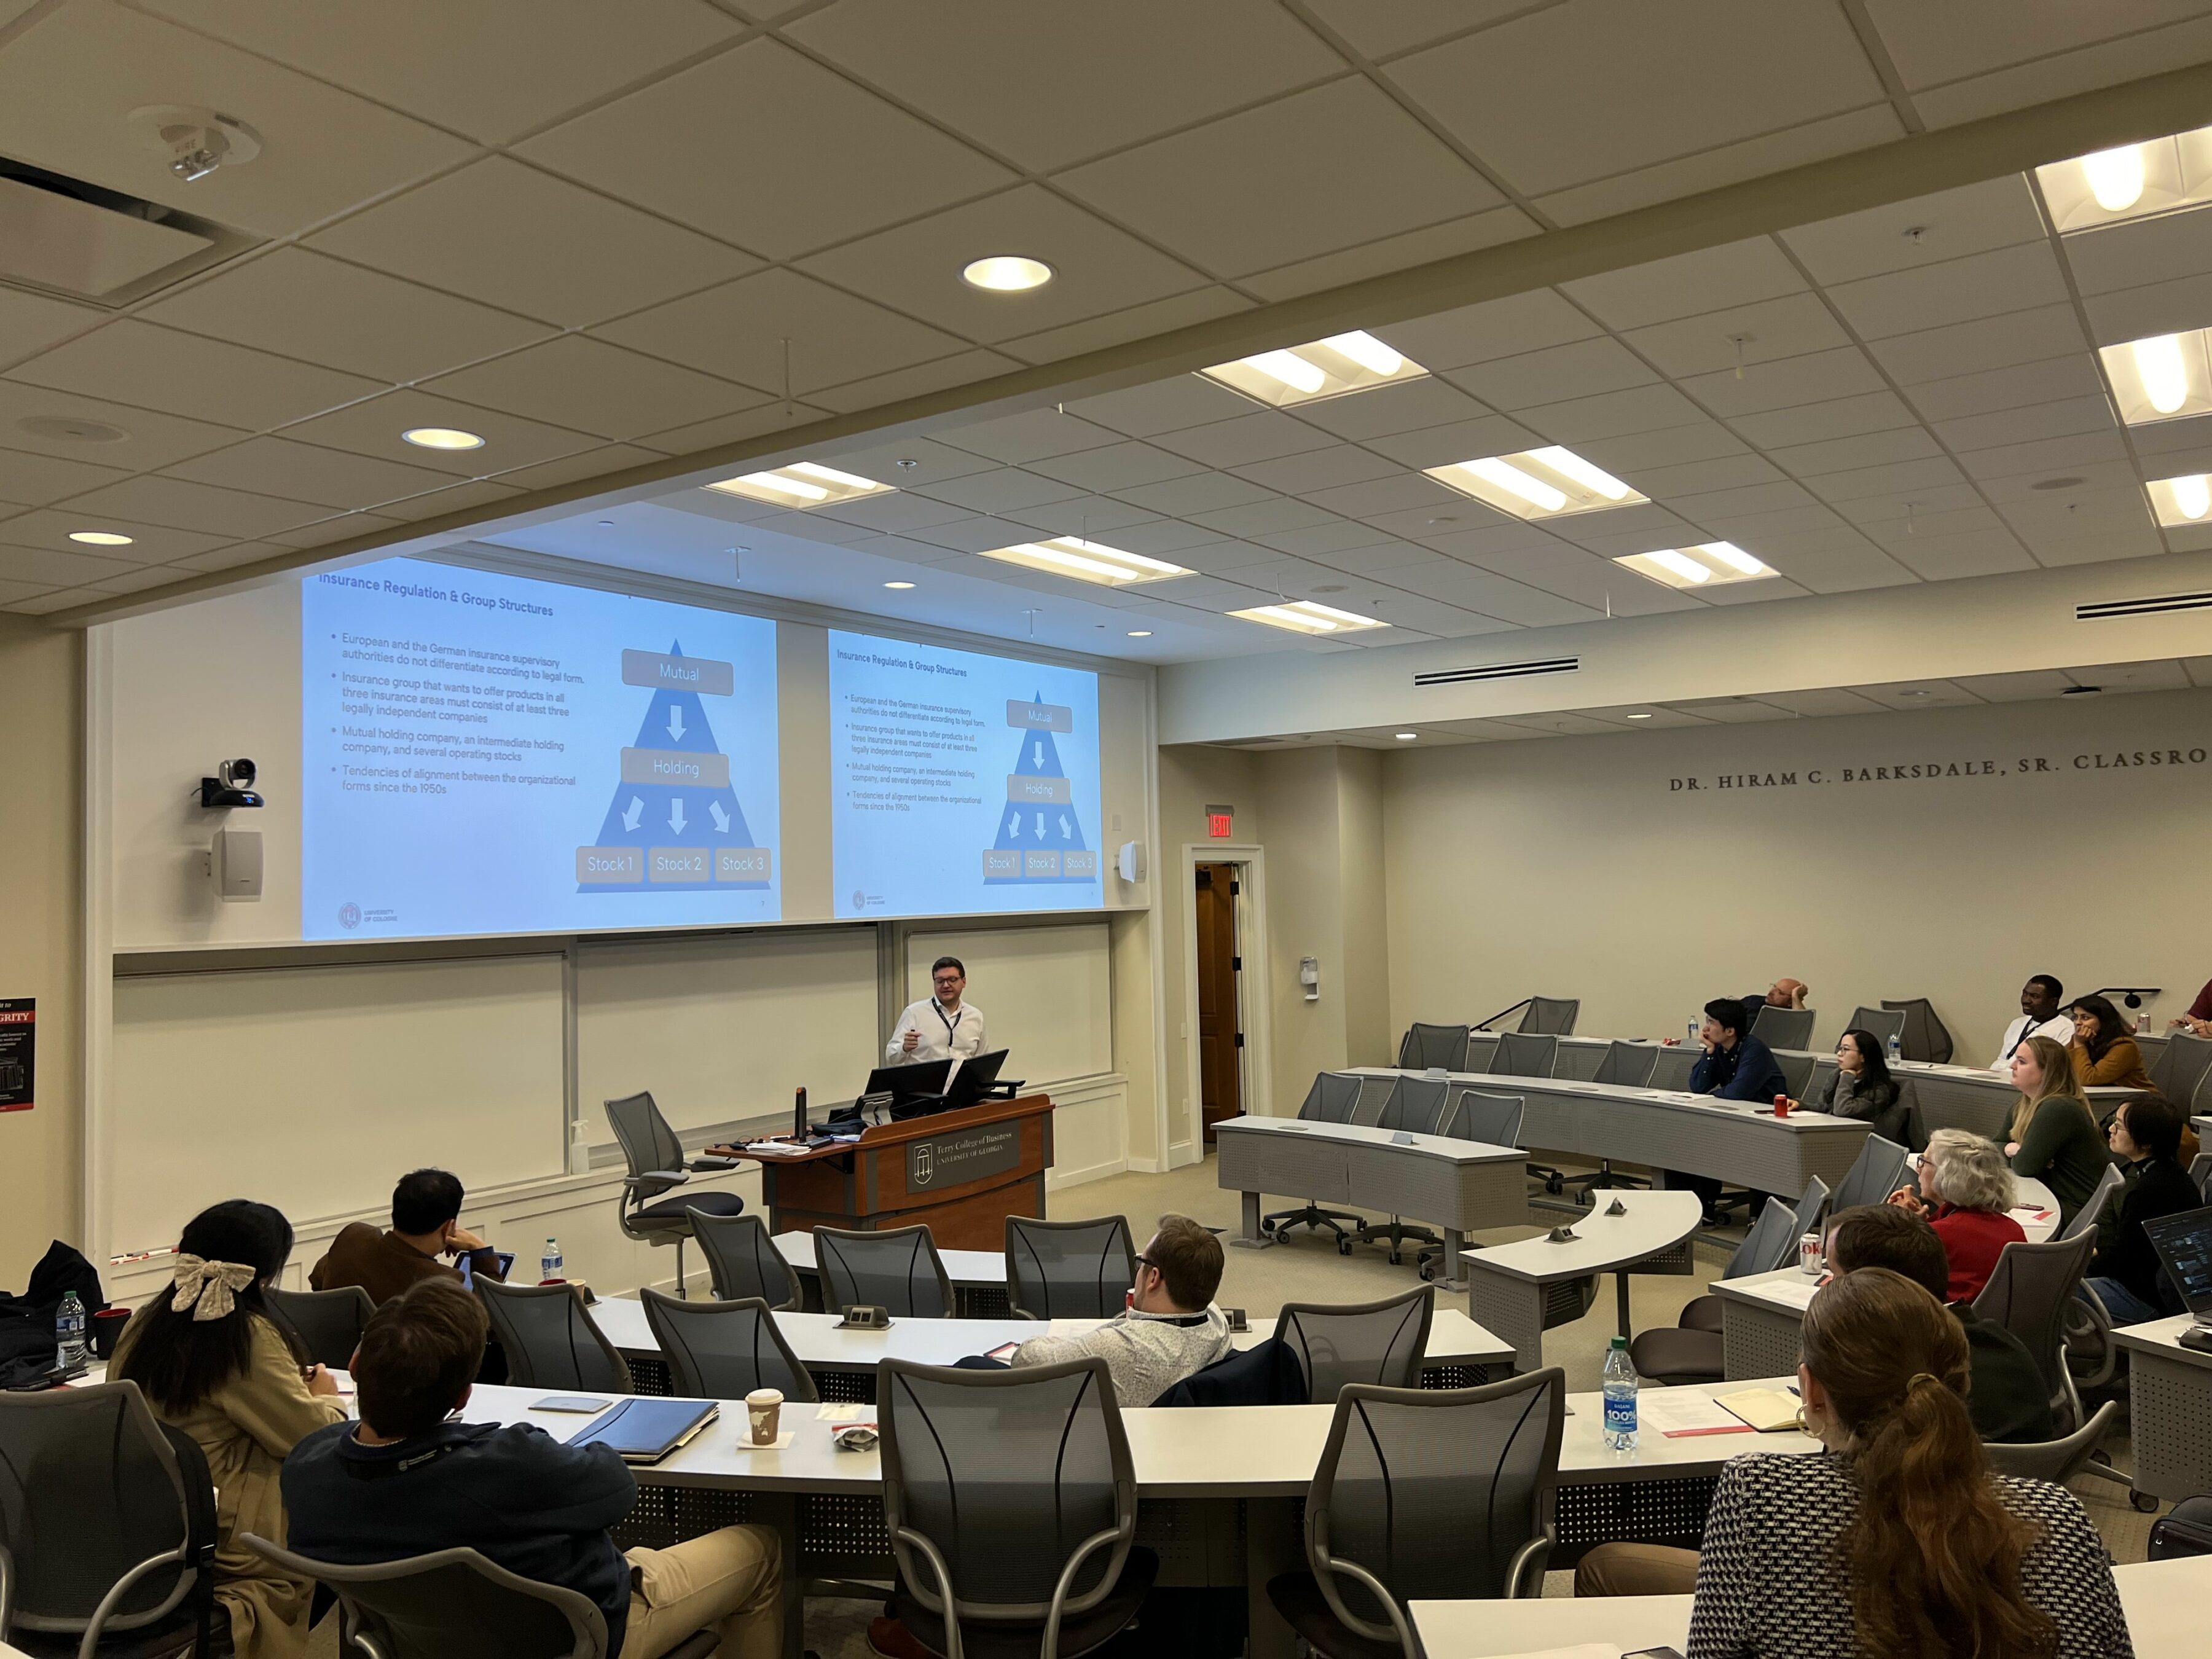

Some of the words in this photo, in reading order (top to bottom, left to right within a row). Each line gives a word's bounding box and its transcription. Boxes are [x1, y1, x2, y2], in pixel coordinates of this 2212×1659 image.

[383, 580, 446, 600] Regulation
[450, 590, 458, 602] &
[461, 592, 496, 610] Group
[499, 598, 553, 616] Structures
[342, 632, 389, 647] European
[391, 640, 409, 649] and
[412, 641, 428, 651] the
[429, 643, 466, 656] German
[468, 648, 510, 661] insurance
[512, 656, 560, 669] supervisory
[342, 649, 394, 662] authorities
[396, 654, 409, 664] do
[412, 657, 428, 666] not
[429, 658, 485, 672] differentiate
[486, 666, 530, 679] according
[531, 670, 541, 678] to
[542, 669, 562, 682] legal
[563, 672, 584, 683] form.
[837, 649, 870, 662] Insurance
[872, 654, 907, 667] Regulation
[909, 660, 914, 669] &
[915, 661, 935, 673] Group
[936, 664, 967, 677] Structures
[661, 664, 699, 681] Mutual
[342, 672, 390, 685] Insurance
[392, 679, 421, 690] group
[423, 680, 442, 690] that
[443, 684, 470, 693] wants
[472, 685, 482, 694] to
[484, 686, 504, 696] offer
[506, 689, 544, 700] products
[546, 692, 554, 701] in
[555, 693, 565, 702] all
[342, 687, 369, 698] three
[371, 689, 418, 702] insurance
[420, 696, 445, 705] areas
[447, 699, 469, 707] must
[471, 700, 503, 710] consist
[504, 702, 514, 711] of
[516, 704, 525, 712] at
[526, 704, 546, 714] least
[547, 706, 570, 716] three
[850, 694, 876, 704] European
[898, 700, 919, 708] German
[919, 703, 943, 712] insurance
[944, 707, 971, 716] supervisory
[342, 702, 374, 716] legally
[376, 705, 436, 718] independent
[438, 712, 488, 723] companies
[851, 706, 879, 715] authorities
[898, 711, 929, 721] differentiate
[930, 716, 954, 725] according
[961, 718, 973, 726] legal
[1029, 710, 1052, 723] Mutual
[851, 723, 877, 732] Insurance
[343, 726, 376, 737] Mutual
[378, 728, 414, 742] holding
[417, 733, 461, 745] company,
[477, 735, 532, 748] intermediate
[533, 739, 564, 752] holding
[342, 743, 391, 755] company,
[393, 745, 411, 755] and
[414, 747, 447, 756] several
[449, 750, 492, 761] operating
[493, 751, 522, 761] stocks
[852, 745, 869, 755] legally
[870, 747, 903, 756] independent
[342, 764, 399, 777] Tendencies
[401, 767, 412, 778] of
[414, 769, 460, 780] alignment
[461, 771, 500, 782] between
[501, 773, 516, 782] the
[518, 775, 576, 785] organizational
[654, 759, 699, 778] Holding
[852, 762, 871, 771] Mutual
[871, 763, 892, 774] holding
[926, 767, 957, 776] intermediate
[957, 770, 975, 779] holding
[1670, 778, 1708, 791] DR.
[1718, 772, 1797, 788] HIRAM
[1808, 771, 1831, 783] C.
[1842, 761, 2006, 782] BARKSDALE,
[2018, 758, 2060, 772] SR.
[2073, 748, 2207, 769] CLASSRO
[342, 780, 371, 791] forms
[374, 782, 399, 792] since
[402, 783, 418, 793] the
[420, 783, 447, 794] 1950s
[852, 775, 879, 783] company,
[910, 778, 935, 786] operating
[852, 790, 884, 799] Tendencies
[892, 793, 917, 801] alignment
[1026, 783, 1053, 797] Holding
[1213, 815, 1230, 836] EXIT
[588, 857, 624, 871] Stock
[628, 857, 633, 871] 1
[657, 857, 691, 871] Stock
[694, 858, 702, 871] 2
[723, 857, 753, 871] Stock
[756, 857, 764, 871] 3
[989, 857, 1011, 869] Stock
[1029, 857, 1049, 869] Stock
[1051, 858, 1056, 868] 2
[1067, 857, 1086, 869] Stock
[1088, 858, 1092, 868] 3
[937, 1145, 954, 1154] Terry
[955, 1139, 978, 1150] College
[979, 1135, 986, 1144] of
[986, 1132, 1011, 1143] Business
[936, 1152, 968, 1165] UNIVERSITY
[979, 1144, 1003, 1155] GEORGIA
[1607, 1410, 1636, 1421] 100%
